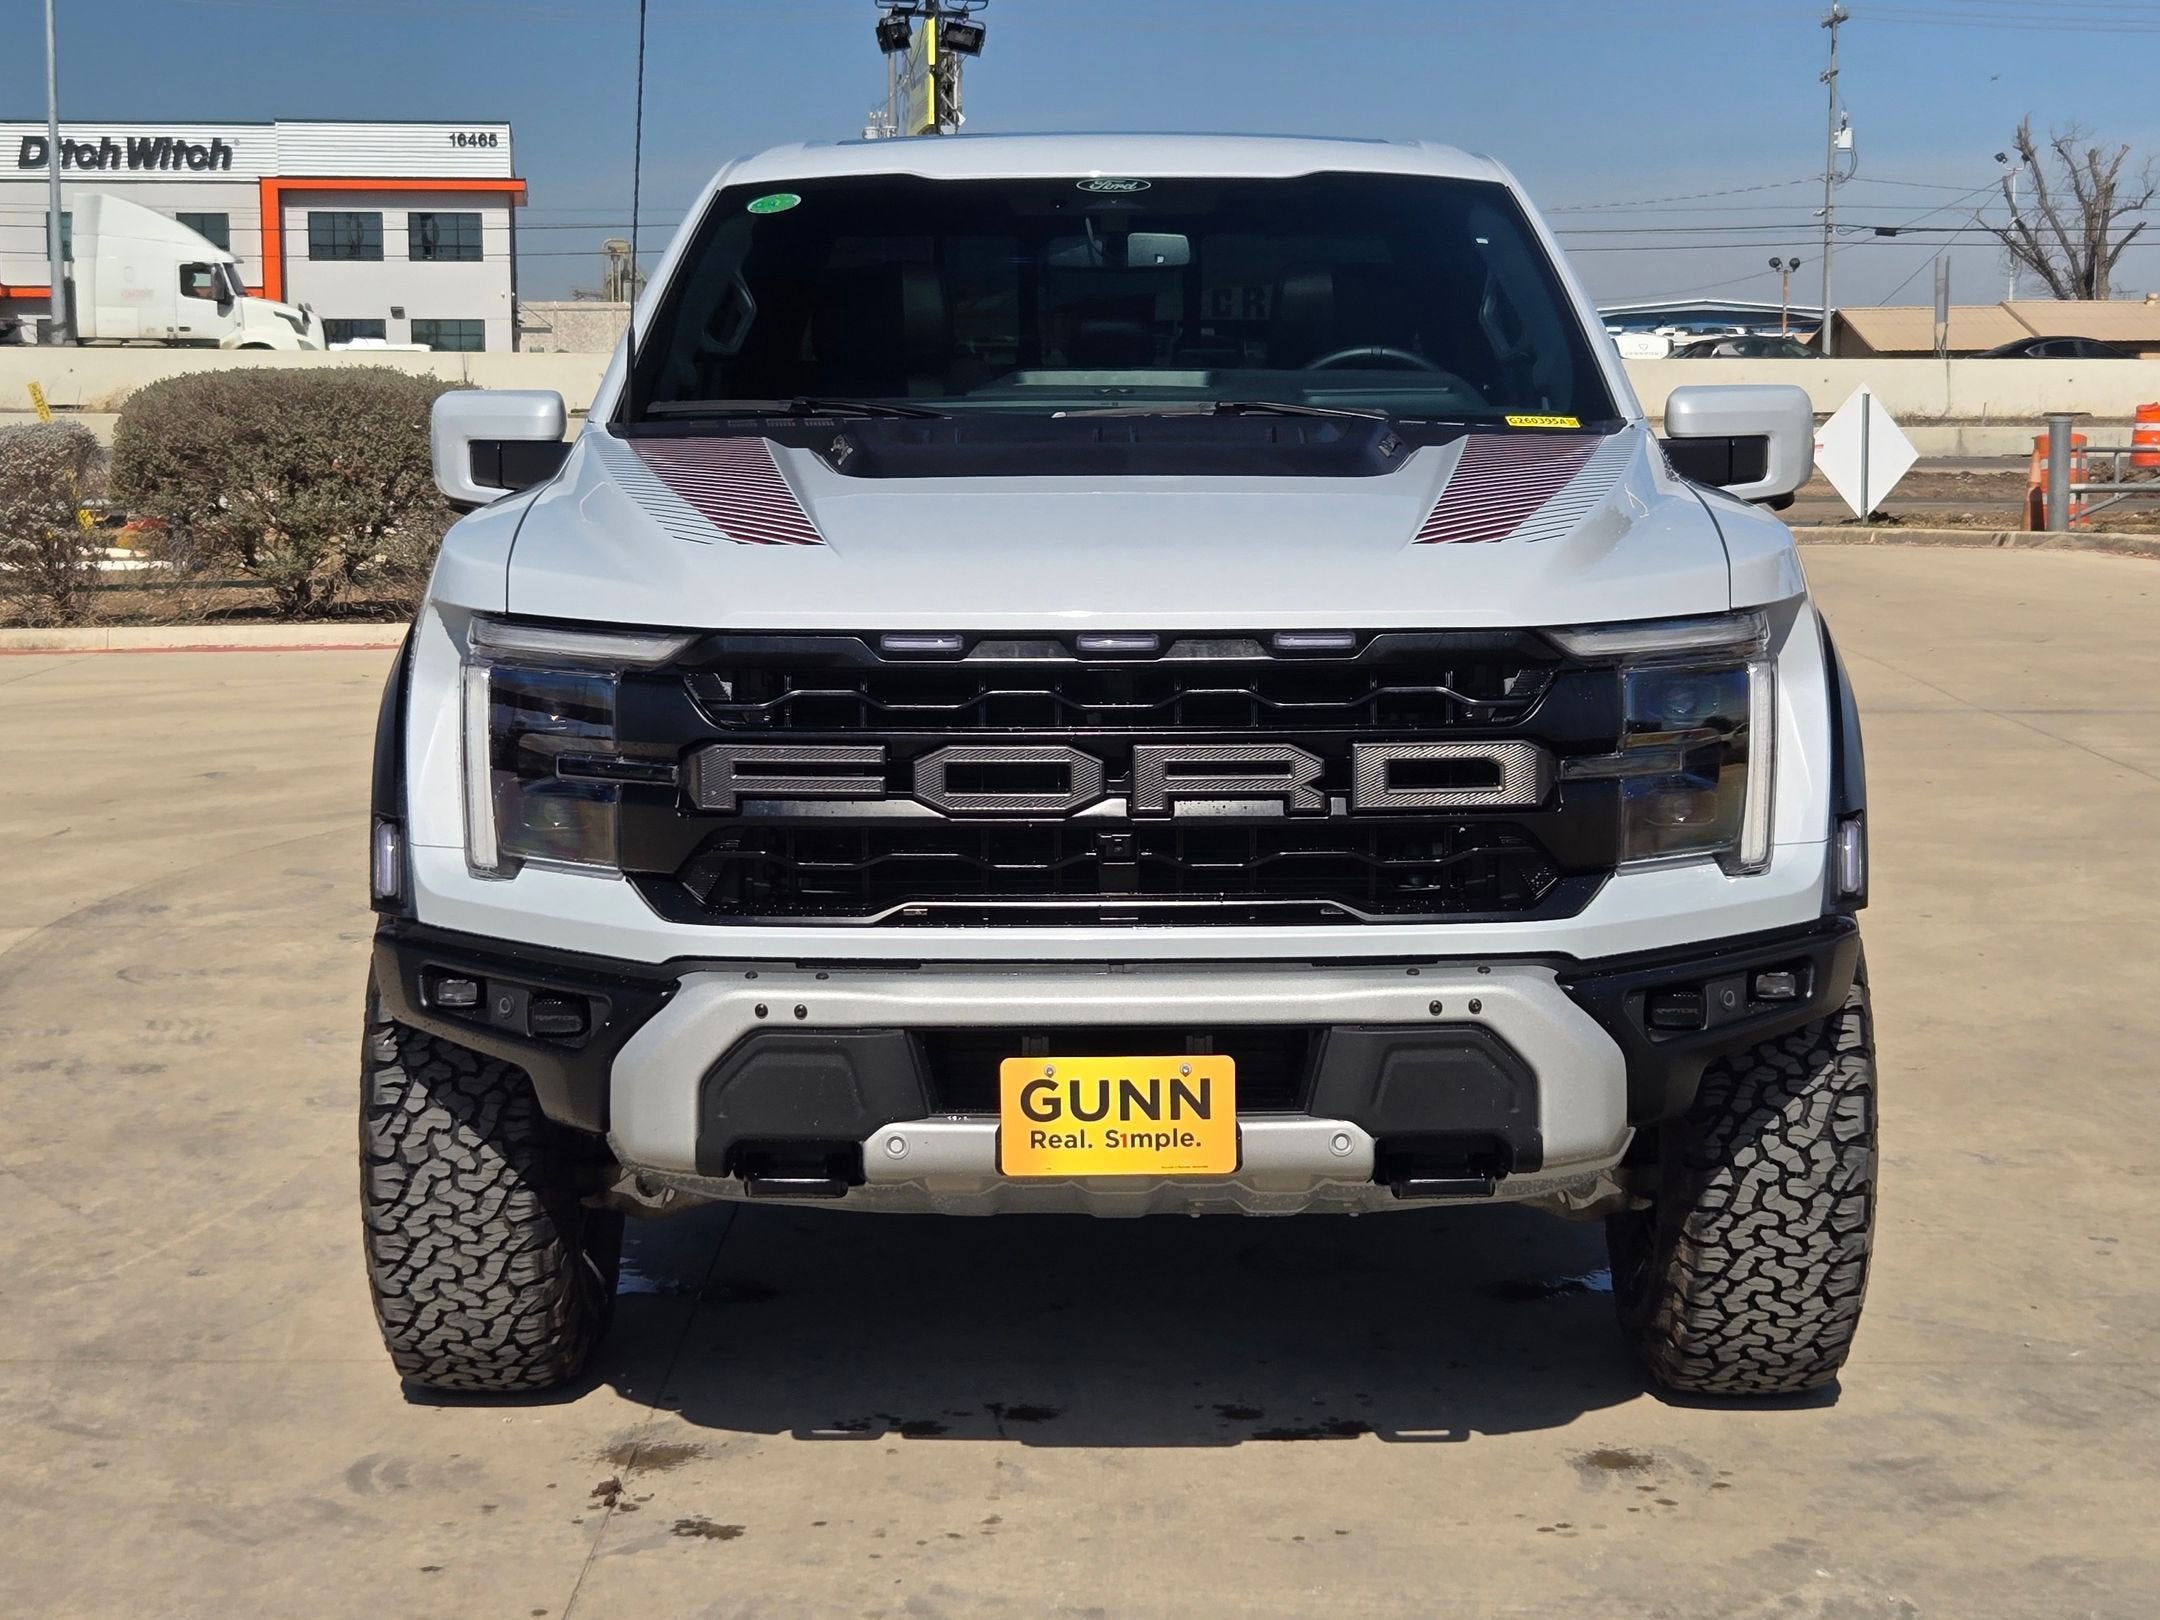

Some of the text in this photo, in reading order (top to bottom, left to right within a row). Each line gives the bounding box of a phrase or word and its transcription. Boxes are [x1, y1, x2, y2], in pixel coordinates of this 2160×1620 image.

[18, 136, 233, 170] Dtch Witch
[449, 132, 498, 148] 16465
[1089, 179, 1138, 190] Ford
[690, 740, 1550, 820] FORD
[1020, 1078, 1211, 1122] GUNN
[1030, 1129, 1093, 1149] Real.
